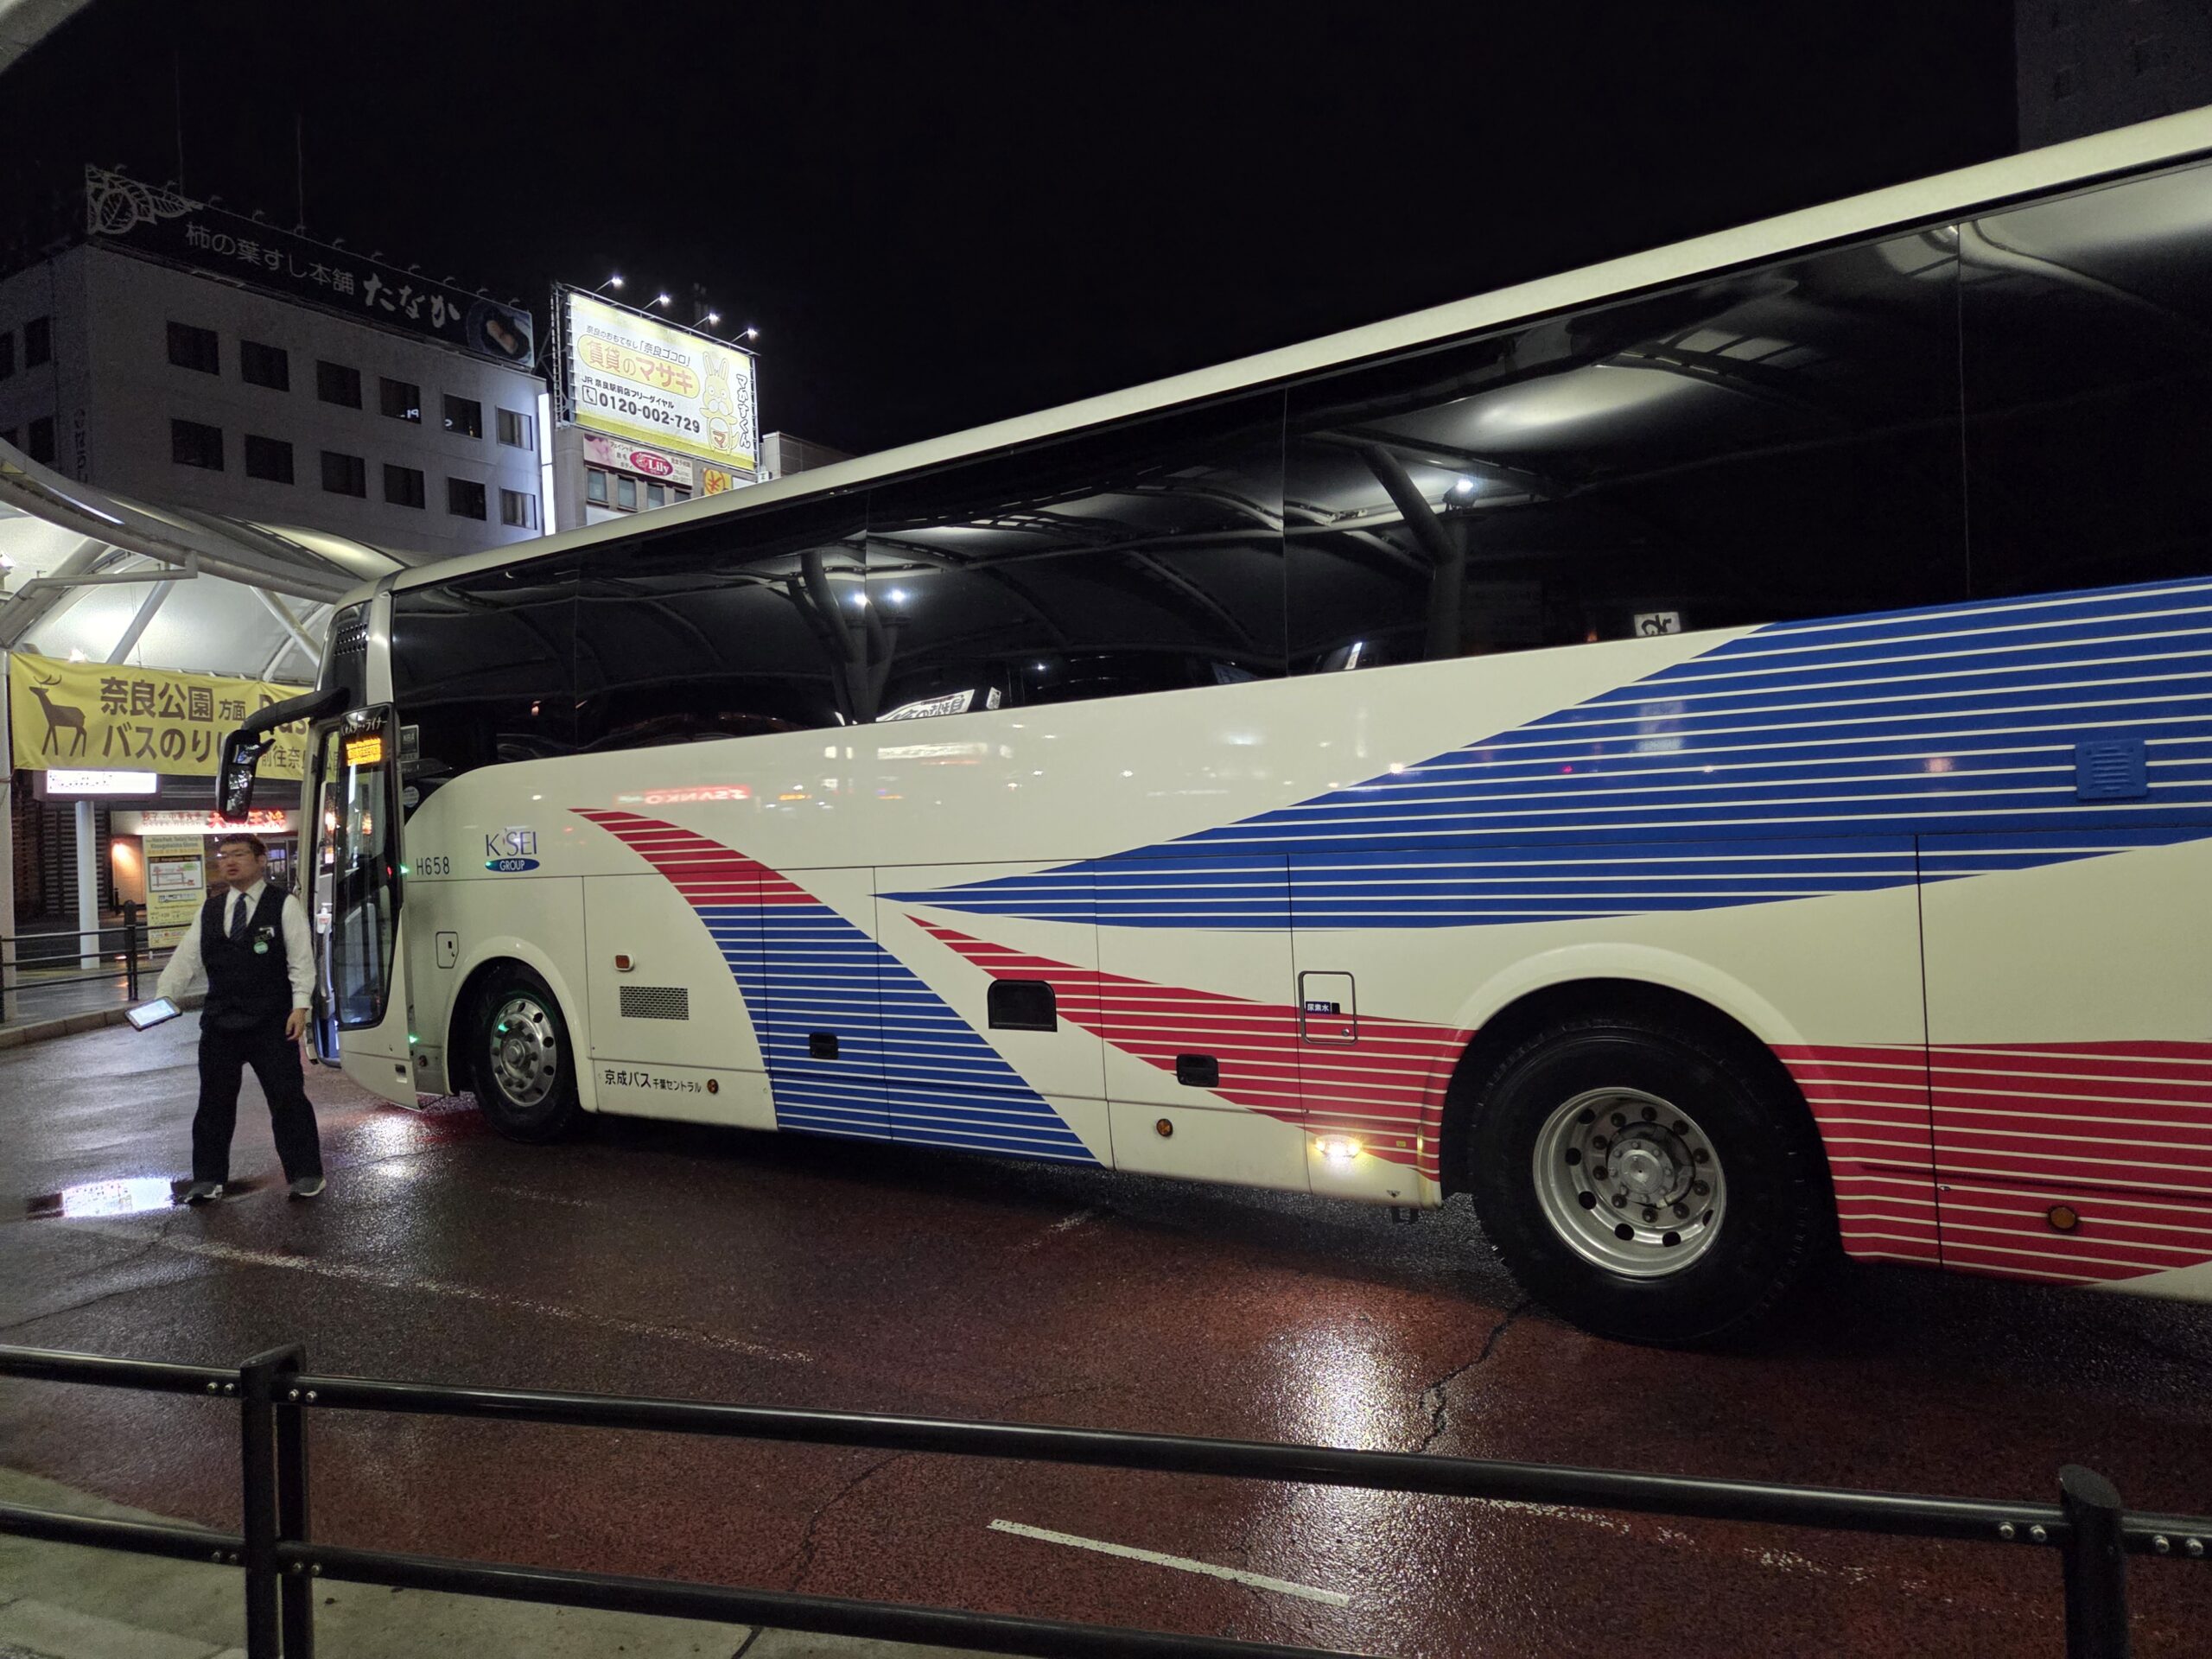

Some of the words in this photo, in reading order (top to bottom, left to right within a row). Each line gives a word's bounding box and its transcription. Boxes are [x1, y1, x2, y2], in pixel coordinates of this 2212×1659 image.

[186, 221, 354, 296] 柿の葉すし本舗
[363, 273, 461, 328] たなか
[587, 340, 694, 395] 賃貸のマサキ
[582, 375, 594, 385] JR
[599, 392, 701, 434] 0120-002-729
[648, 459, 671, 476] Lily
[100, 677, 214, 722] 奈良公園
[218, 698, 246, 722] 方面
[102, 722, 222, 764] バスのり
[207, 810, 287, 830] 大王将
[416, 856, 450, 875] H658
[499, 860, 525, 871] GROUP
[604, 1069, 652, 1089] 京成バス
[652, 1077, 702, 1093] 千葉セントラル
